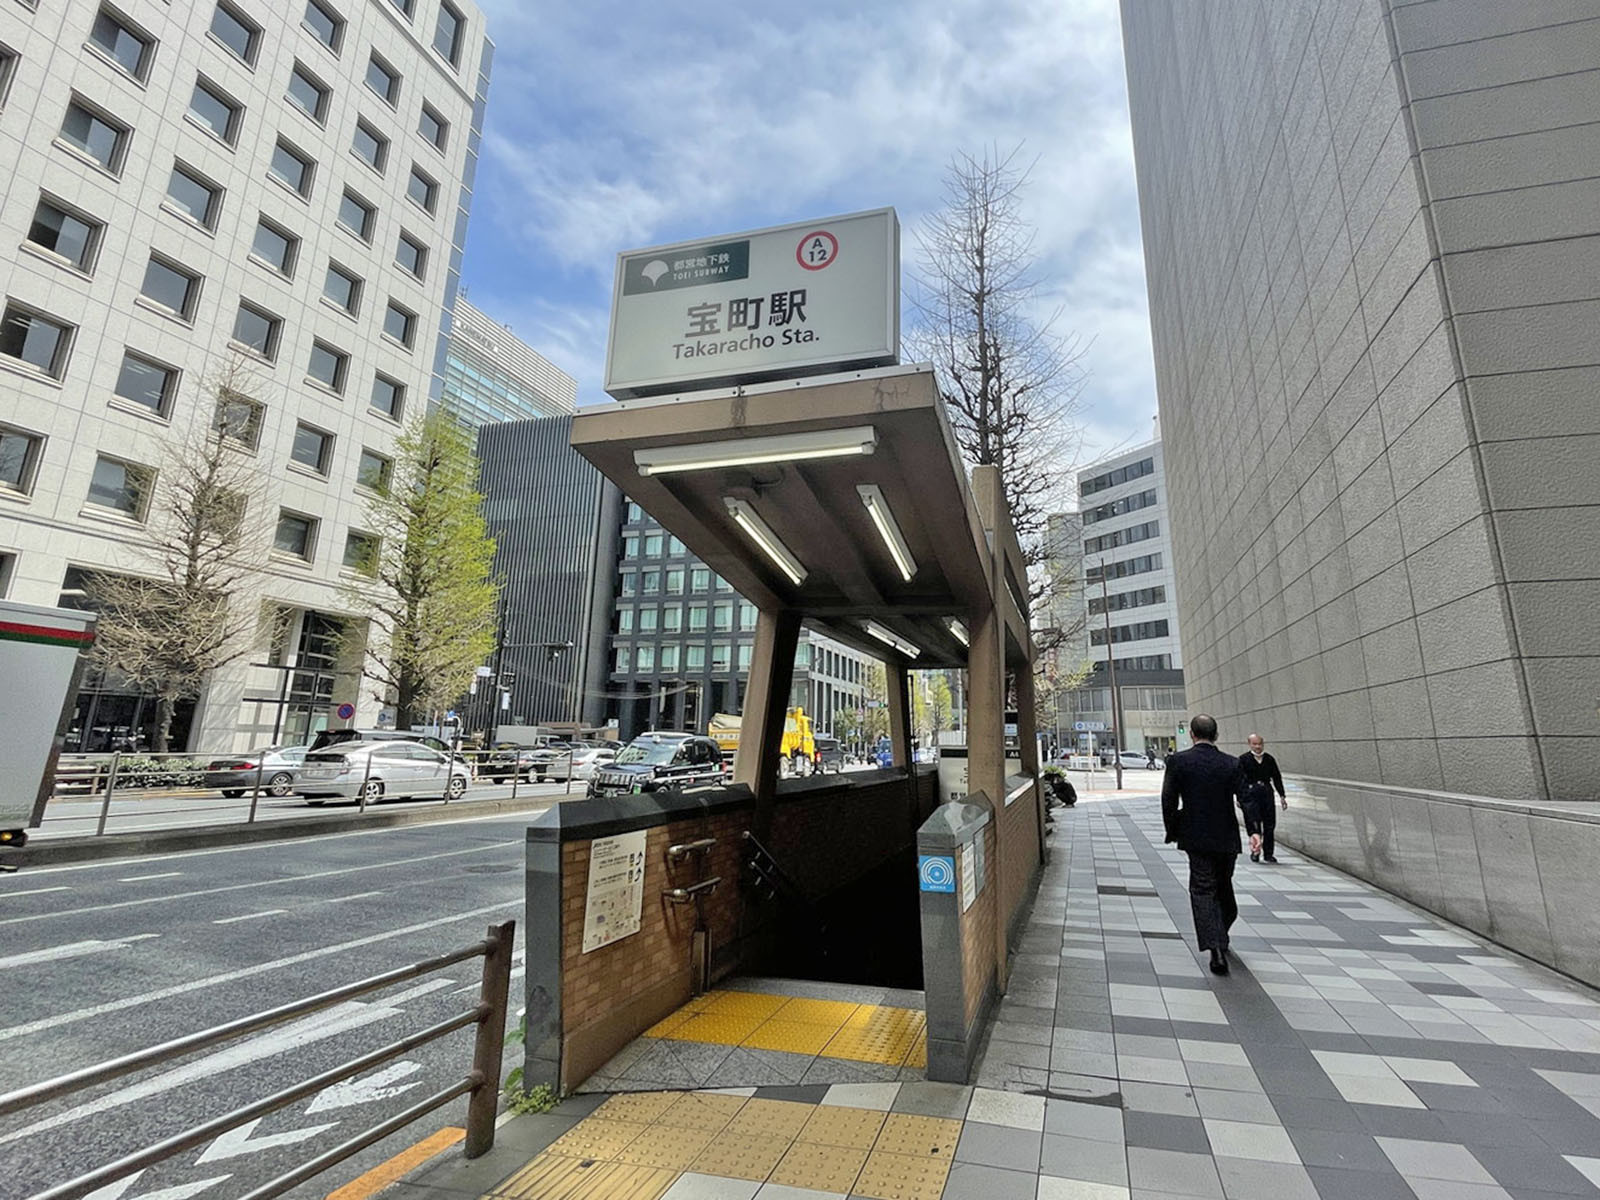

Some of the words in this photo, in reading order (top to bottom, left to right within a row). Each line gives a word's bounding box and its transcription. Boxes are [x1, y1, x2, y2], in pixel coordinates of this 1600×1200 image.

[812, 238, 823, 249] A
[674, 252, 730, 271] 都営地下鉄
[809, 249, 827, 262] 12
[673, 271, 691, 280] TOEI
[694, 265, 730, 277] SUBWAY
[685, 289, 807, 338] 宝町駅
[672, 333, 775, 360] Takaracho
[782, 328, 821, 346] Sta.
